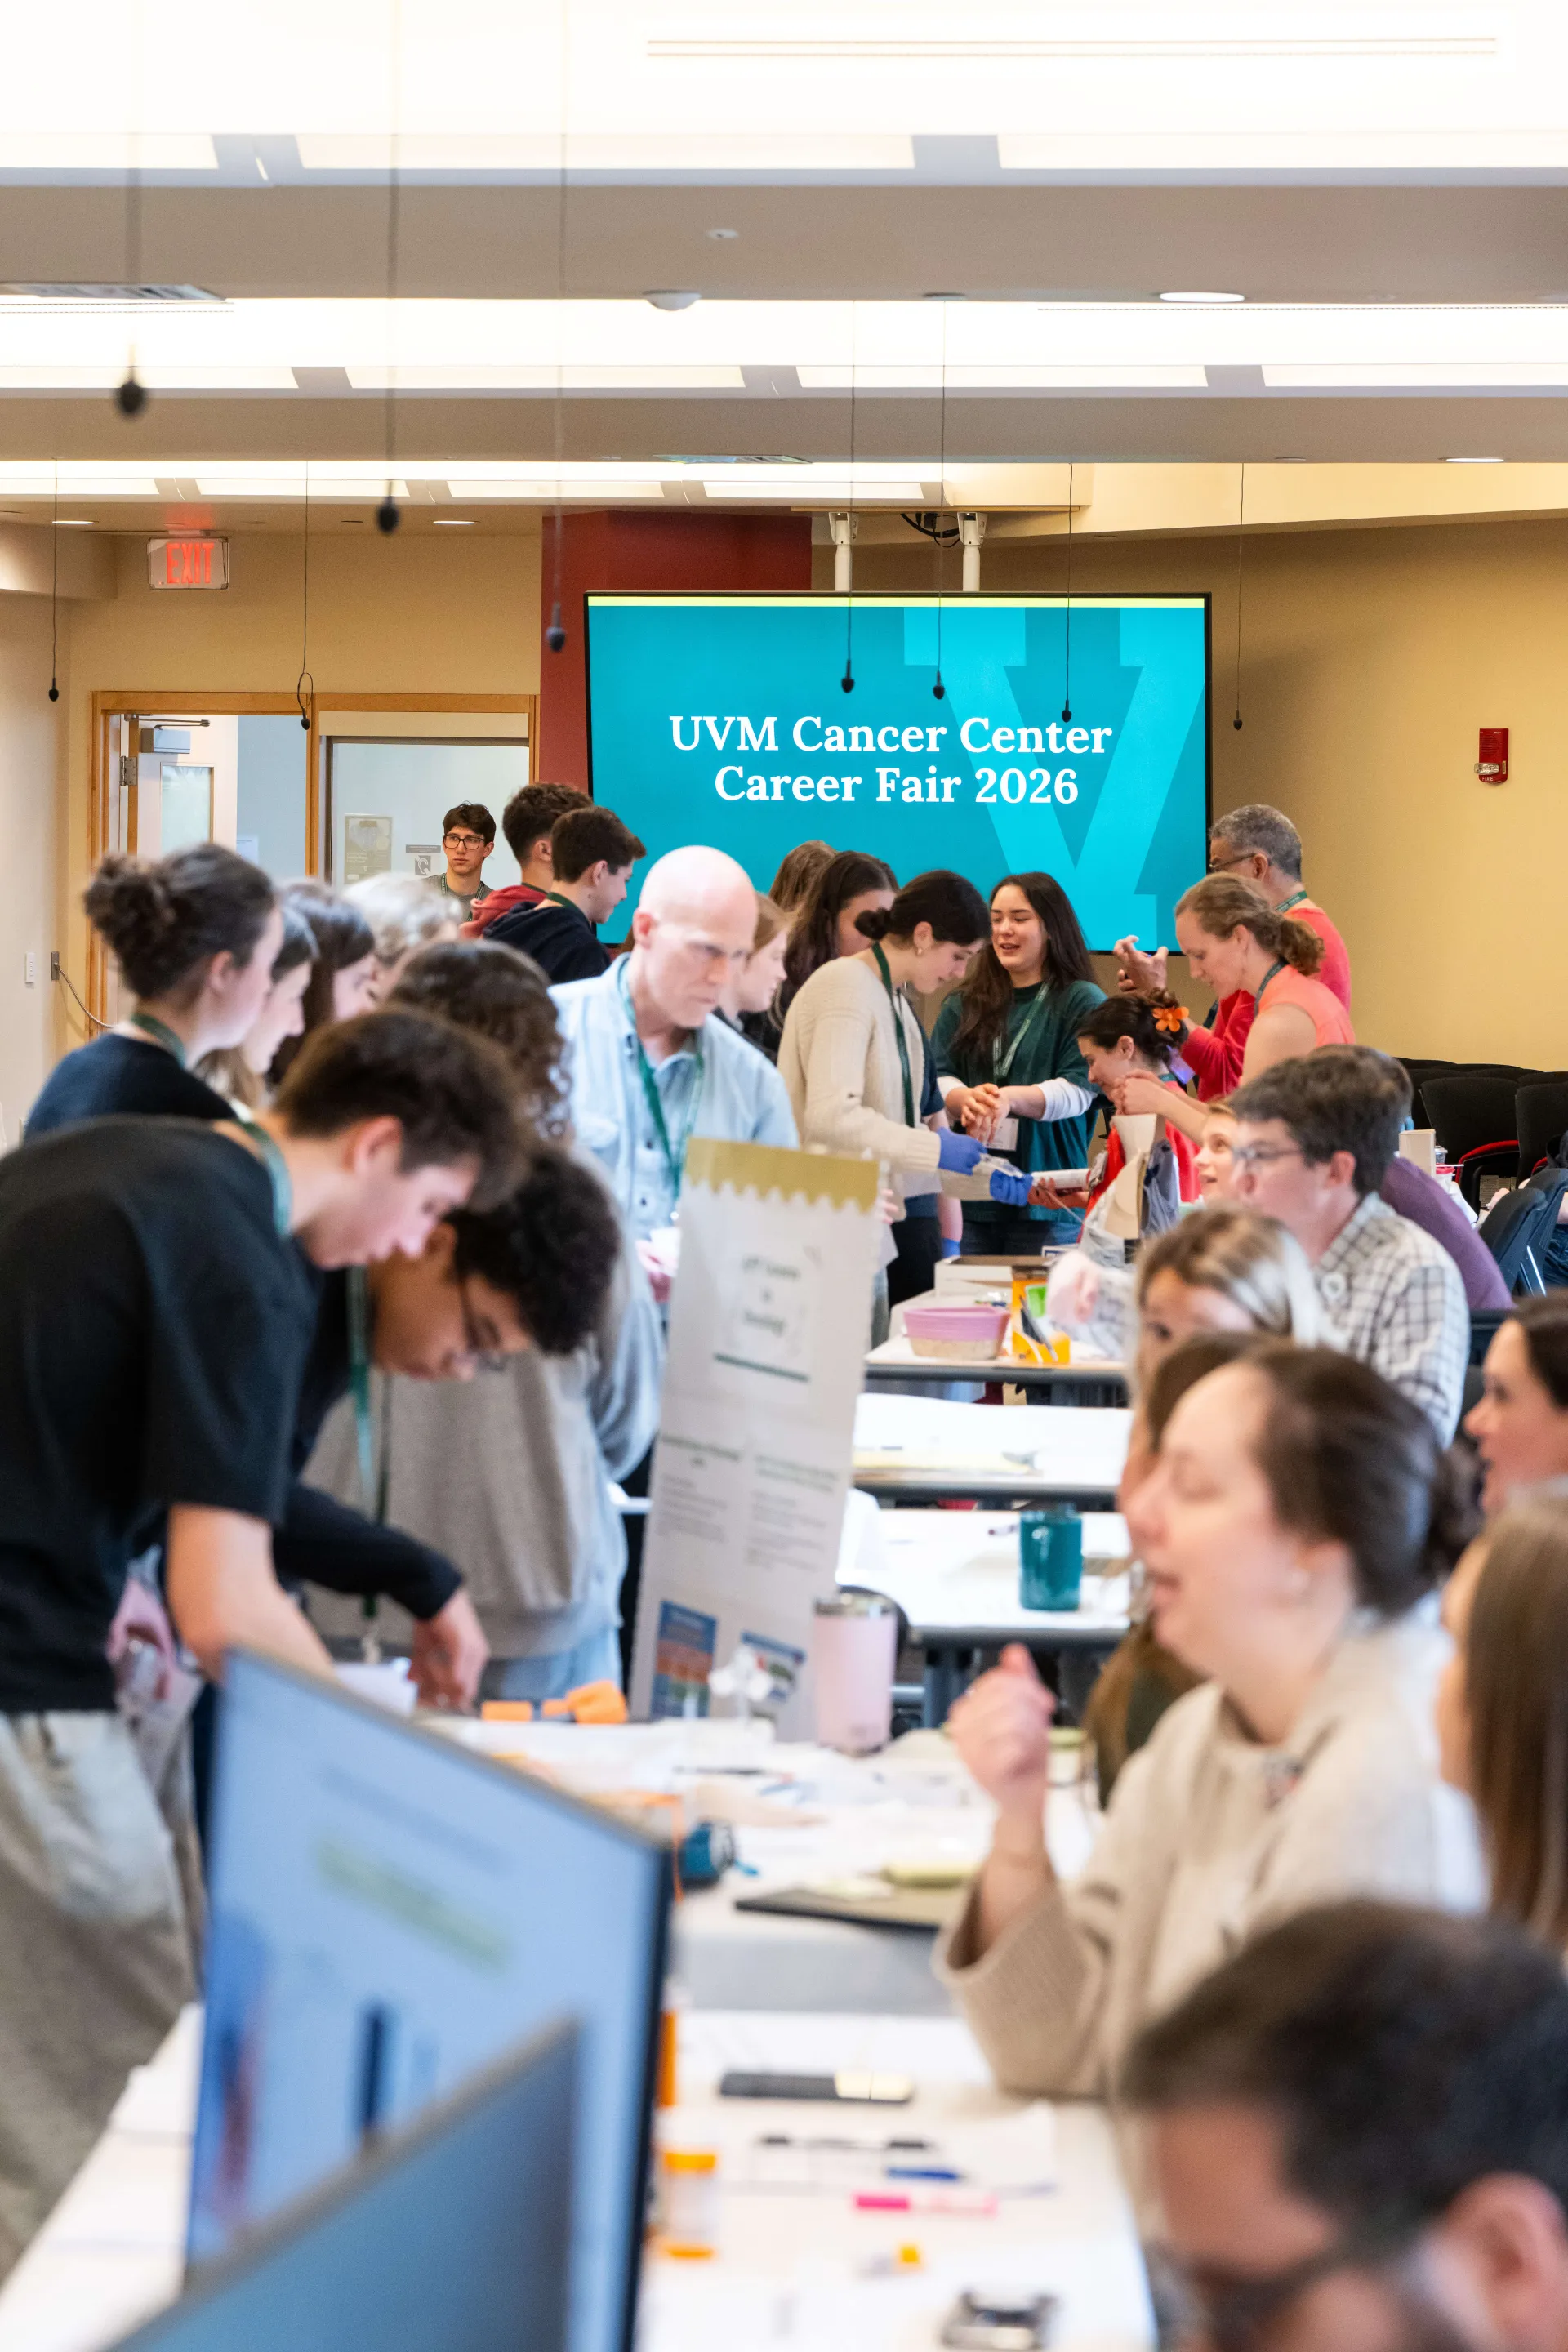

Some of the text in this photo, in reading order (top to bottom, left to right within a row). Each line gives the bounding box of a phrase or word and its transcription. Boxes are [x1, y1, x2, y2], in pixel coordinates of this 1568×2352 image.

[167, 542, 215, 584] EXIT
[669, 715, 1113, 754] UVM Cancer Center
[715, 765, 1078, 804] Career Fair 2026
